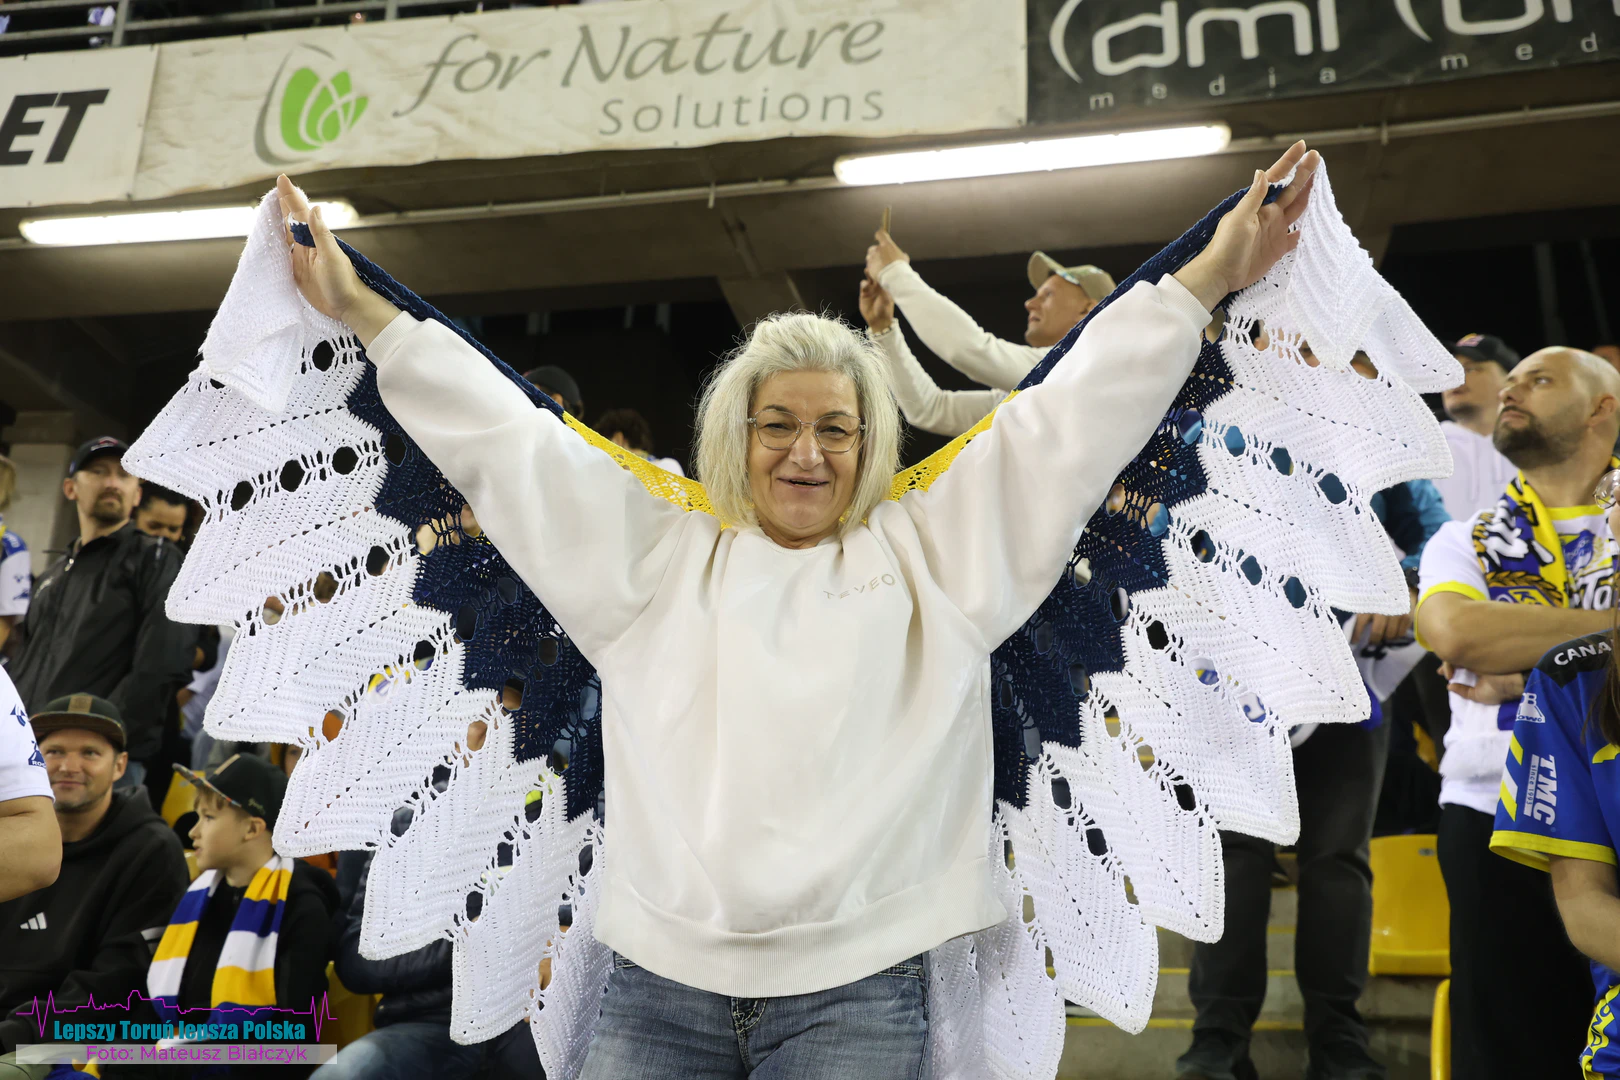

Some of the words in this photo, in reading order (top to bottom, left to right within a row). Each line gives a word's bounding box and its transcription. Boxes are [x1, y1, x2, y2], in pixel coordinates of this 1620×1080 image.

[391, 33, 551, 118] for
[560, 12, 886, 88] Nature
[1089, 66, 1337, 111] media
[599, 87, 885, 136] Solutions
[822, 573, 897, 599] TEVEO
[1553, 638, 1614, 666] CANA
[1533, 754, 1557, 826] TMC
